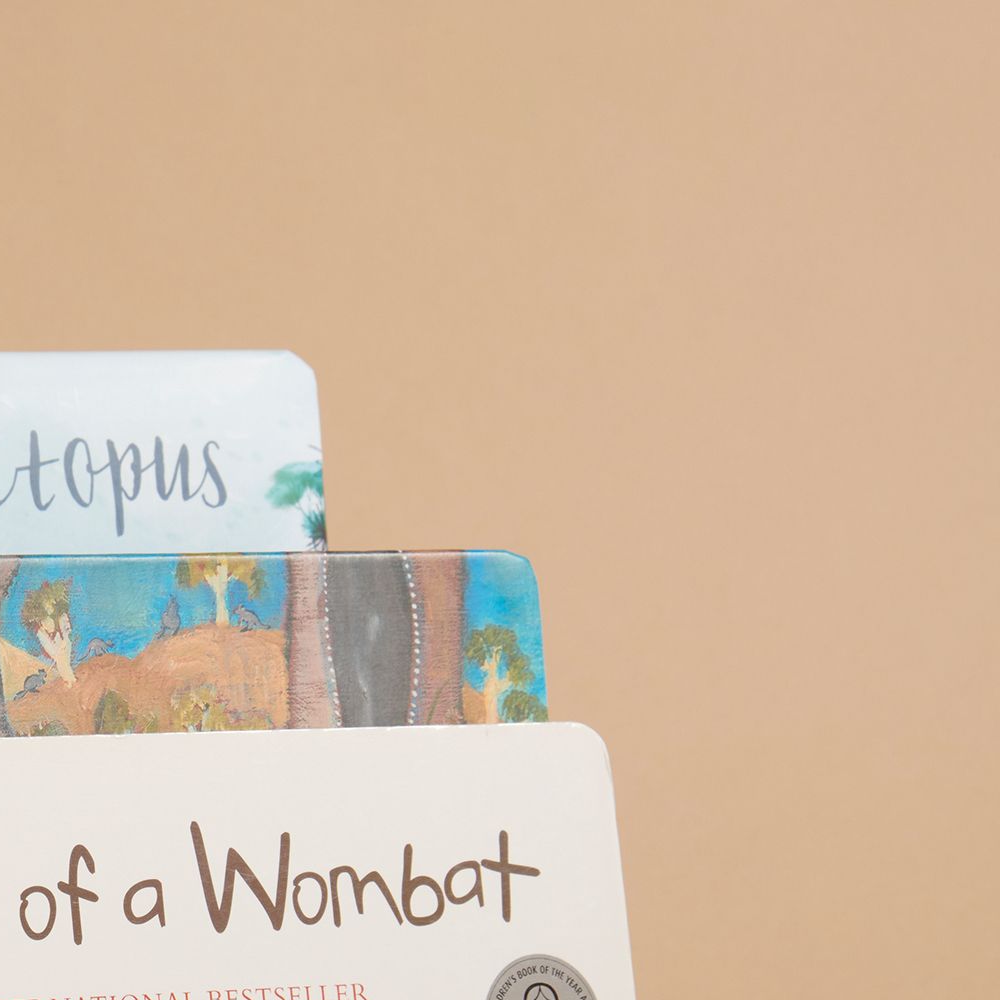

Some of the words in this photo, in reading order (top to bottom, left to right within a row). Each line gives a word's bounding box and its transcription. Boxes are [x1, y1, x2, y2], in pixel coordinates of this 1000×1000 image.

[19, 844, 99, 945] of
[123, 879, 166, 927] a
[190, 821, 541, 933] Wombat
[516, 965, 538, 980] BOOK
[539, 964, 551, 974] OF
[551, 966, 565, 981] THE
[565, 975, 583, 996] YEAR
